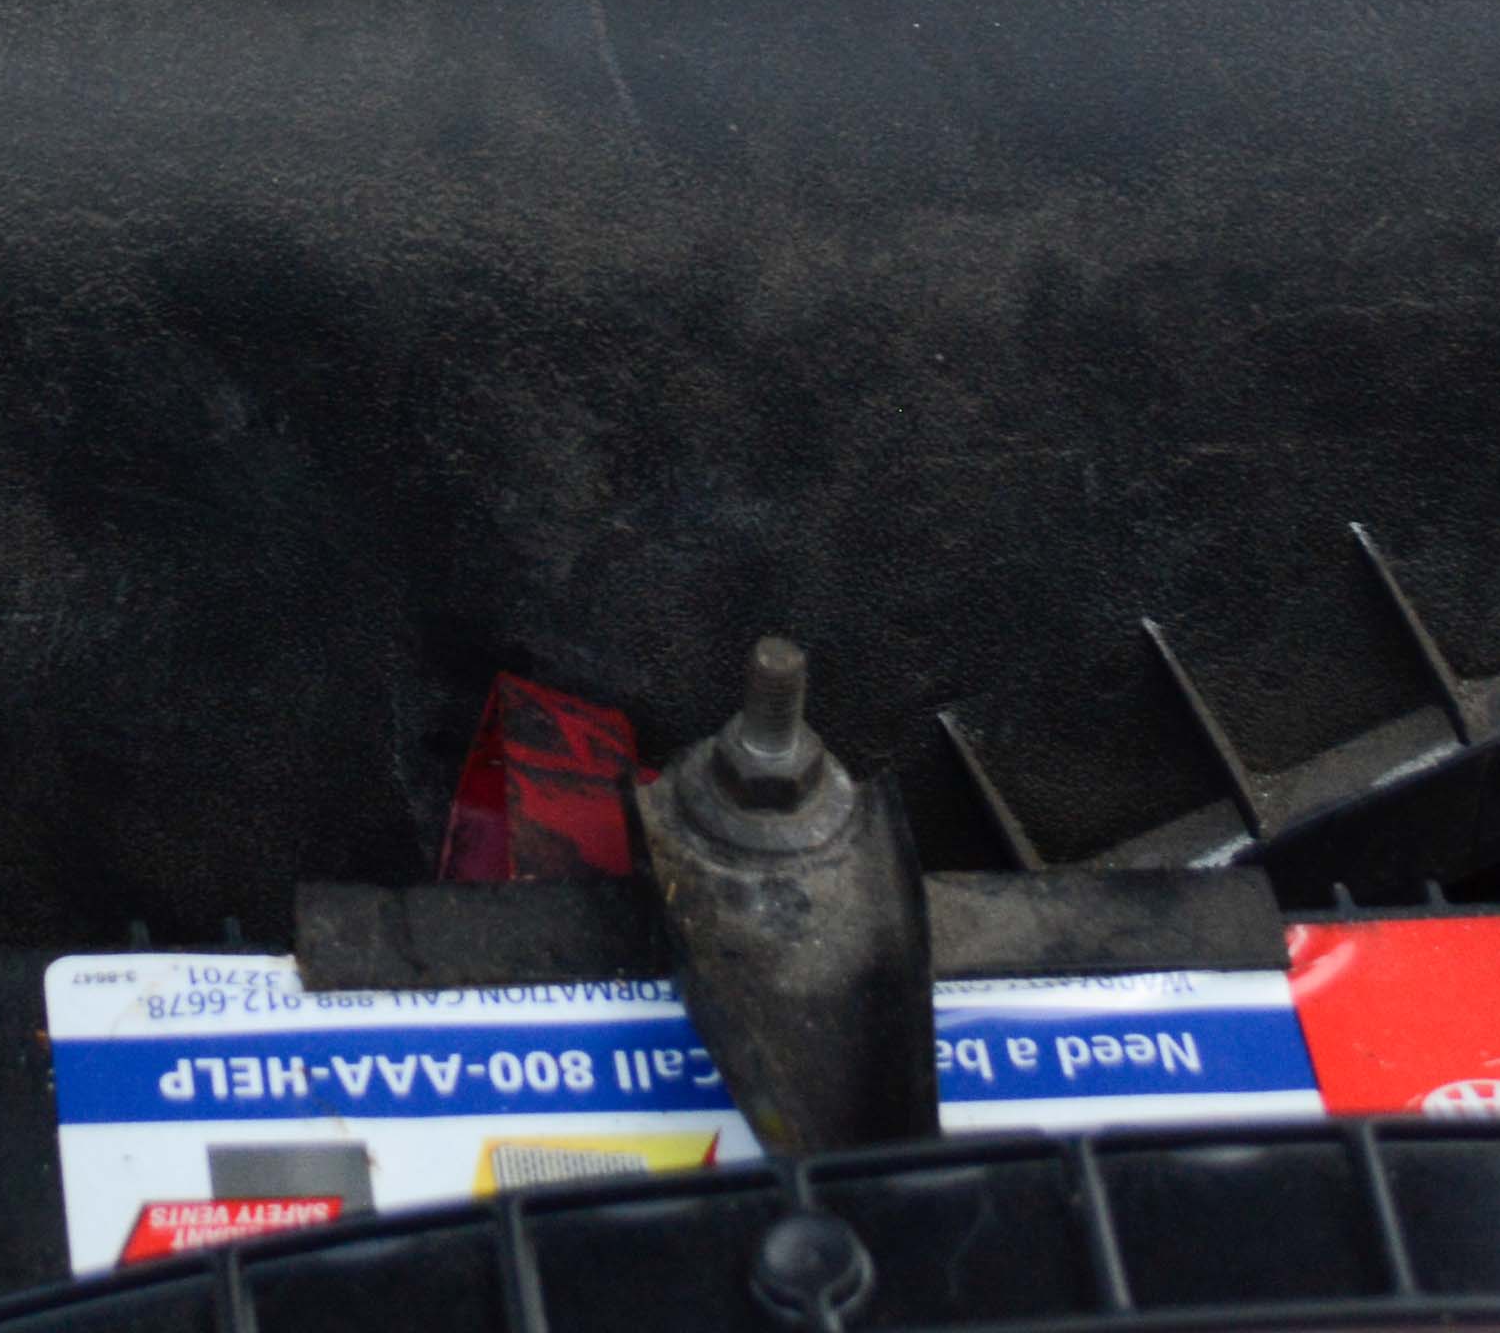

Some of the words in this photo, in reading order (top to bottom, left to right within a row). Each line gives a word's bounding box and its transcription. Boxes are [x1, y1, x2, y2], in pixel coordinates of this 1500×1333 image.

[613, 1048, 724, 1093] Call
[1007, 1038, 1038, 1070] a
[1055, 1032, 1201, 1079] Need
[159, 1050, 596, 1101] 800-AAA-HELP
[149, 1204, 231, 1228] VENTS
[237, 1201, 329, 1226] SAFETY
